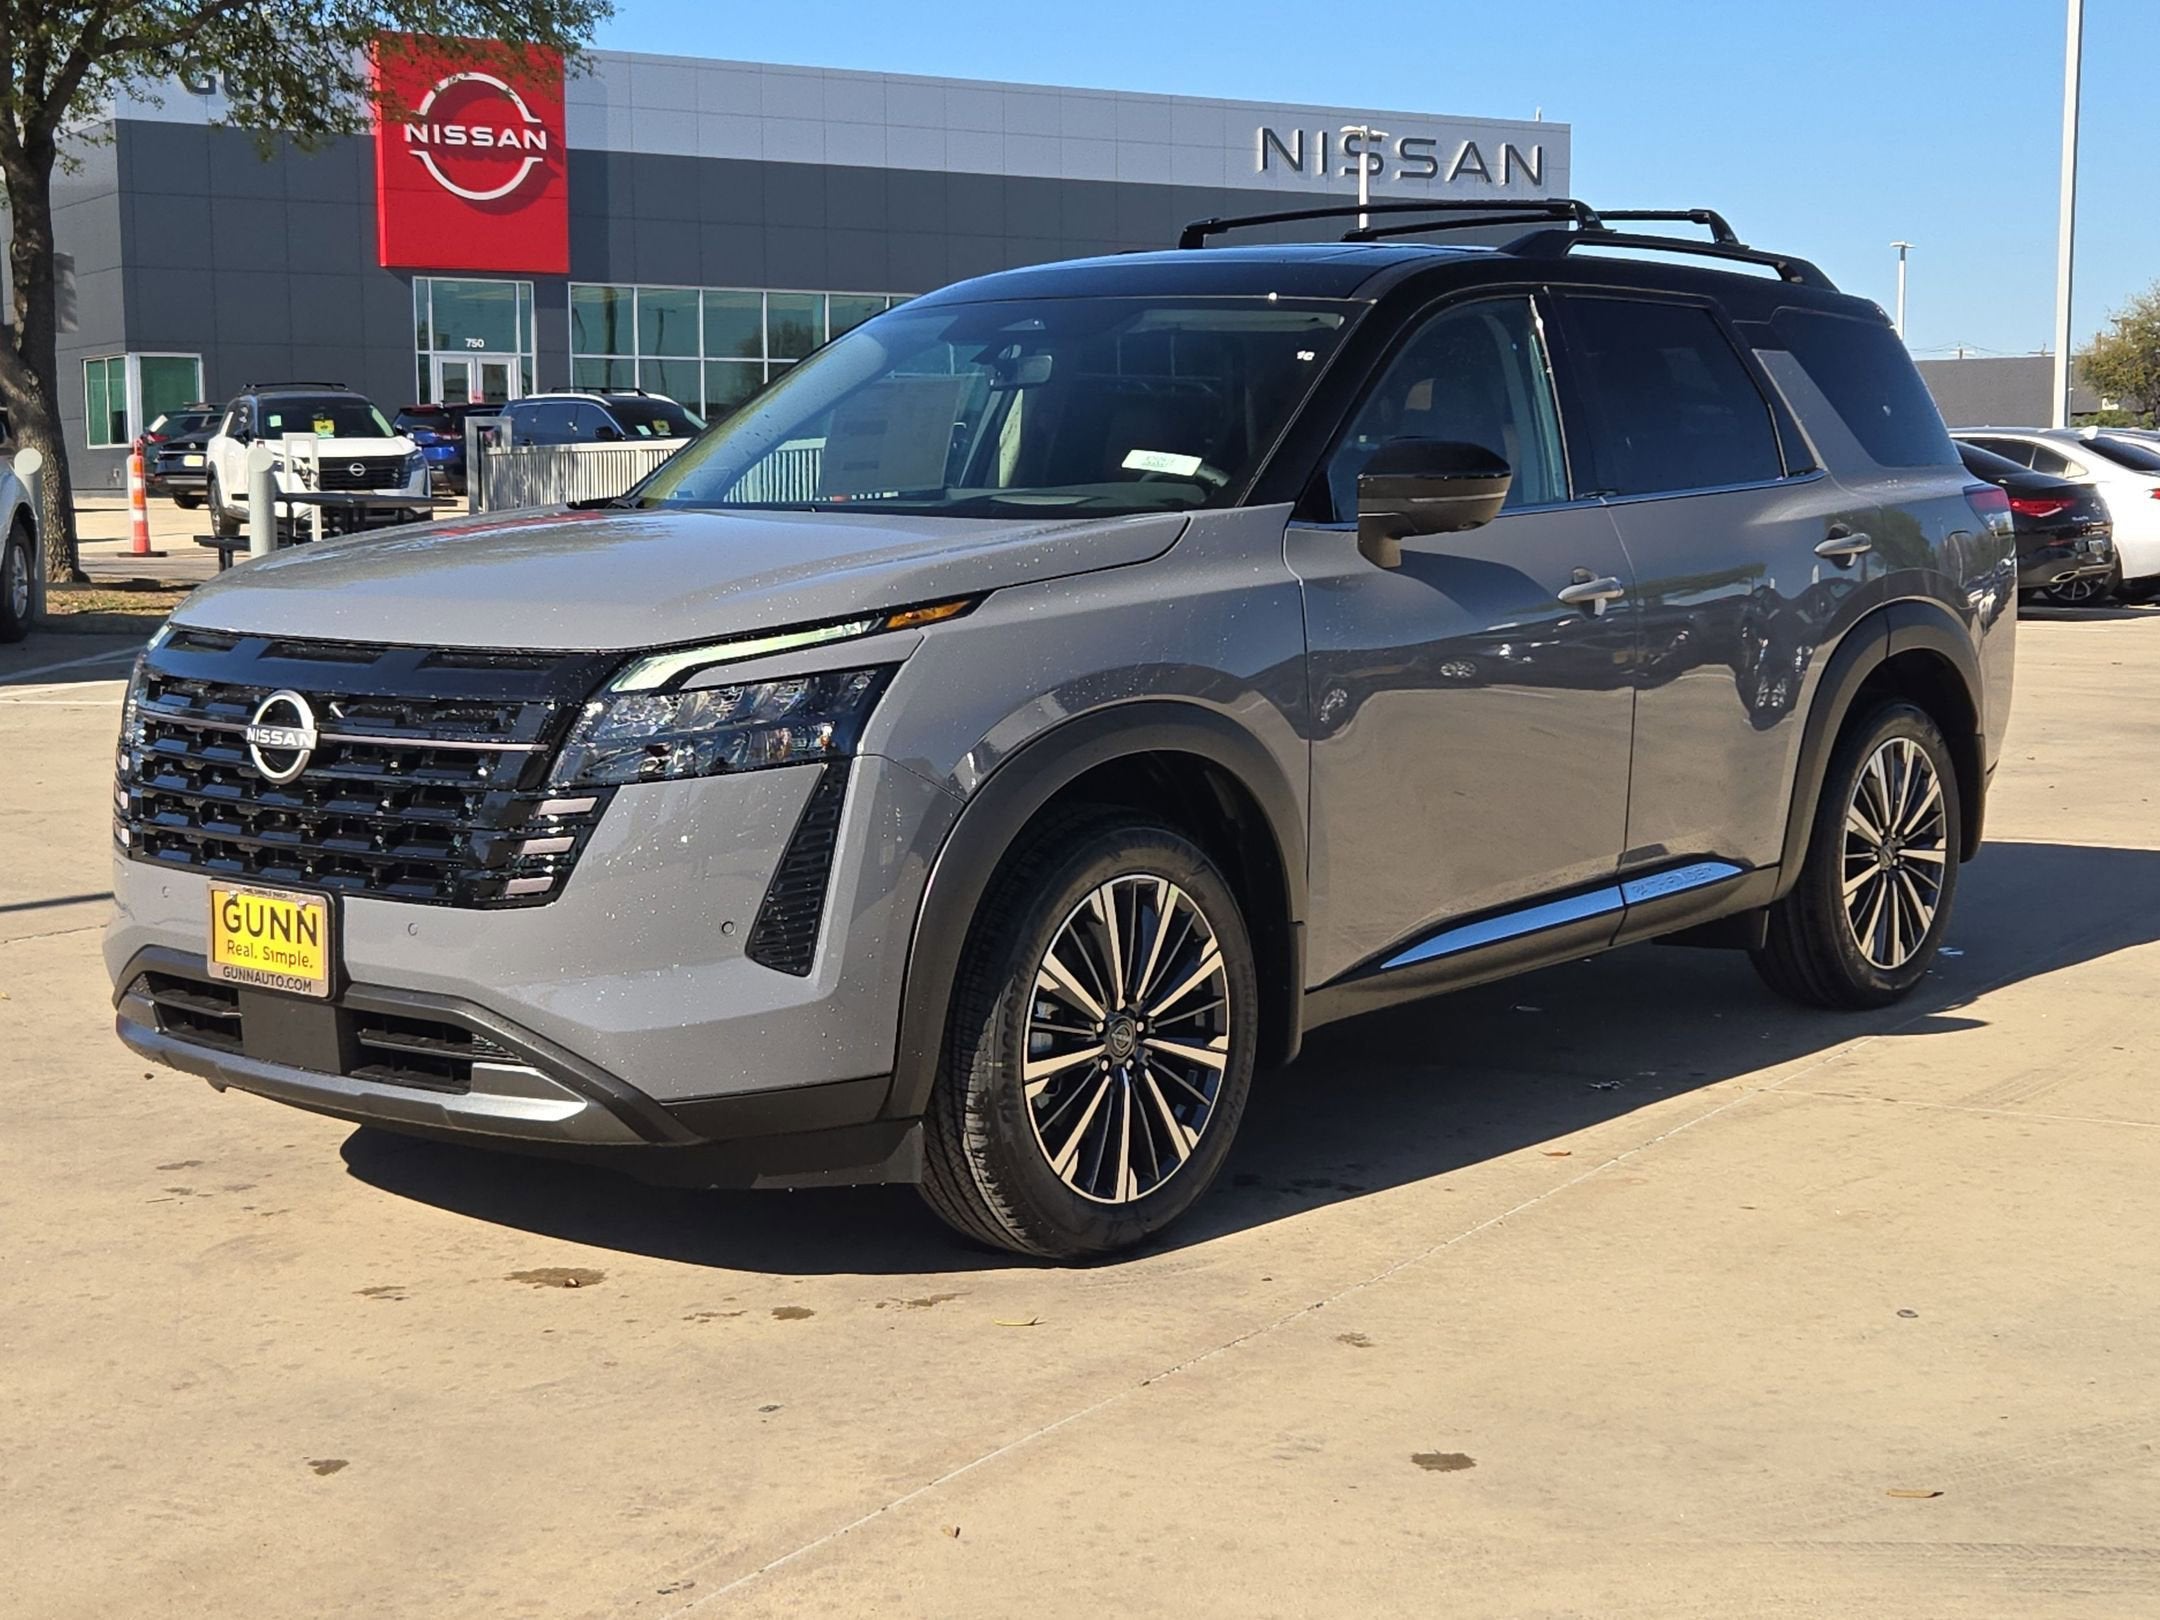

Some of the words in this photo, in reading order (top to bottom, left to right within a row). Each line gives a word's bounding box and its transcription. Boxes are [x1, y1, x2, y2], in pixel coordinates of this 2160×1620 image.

[404, 123, 547, 150] NISSAN
[1258, 127, 1543, 186] NISSAN
[465, 338, 485, 348] 750
[246, 727, 314, 746] NISSAN
[223, 898, 317, 947] GUNN
[227, 939, 258, 959] Real.
[263, 945, 313, 969] Simple.
[222, 965, 312, 992] GUNNAUTO.COM
